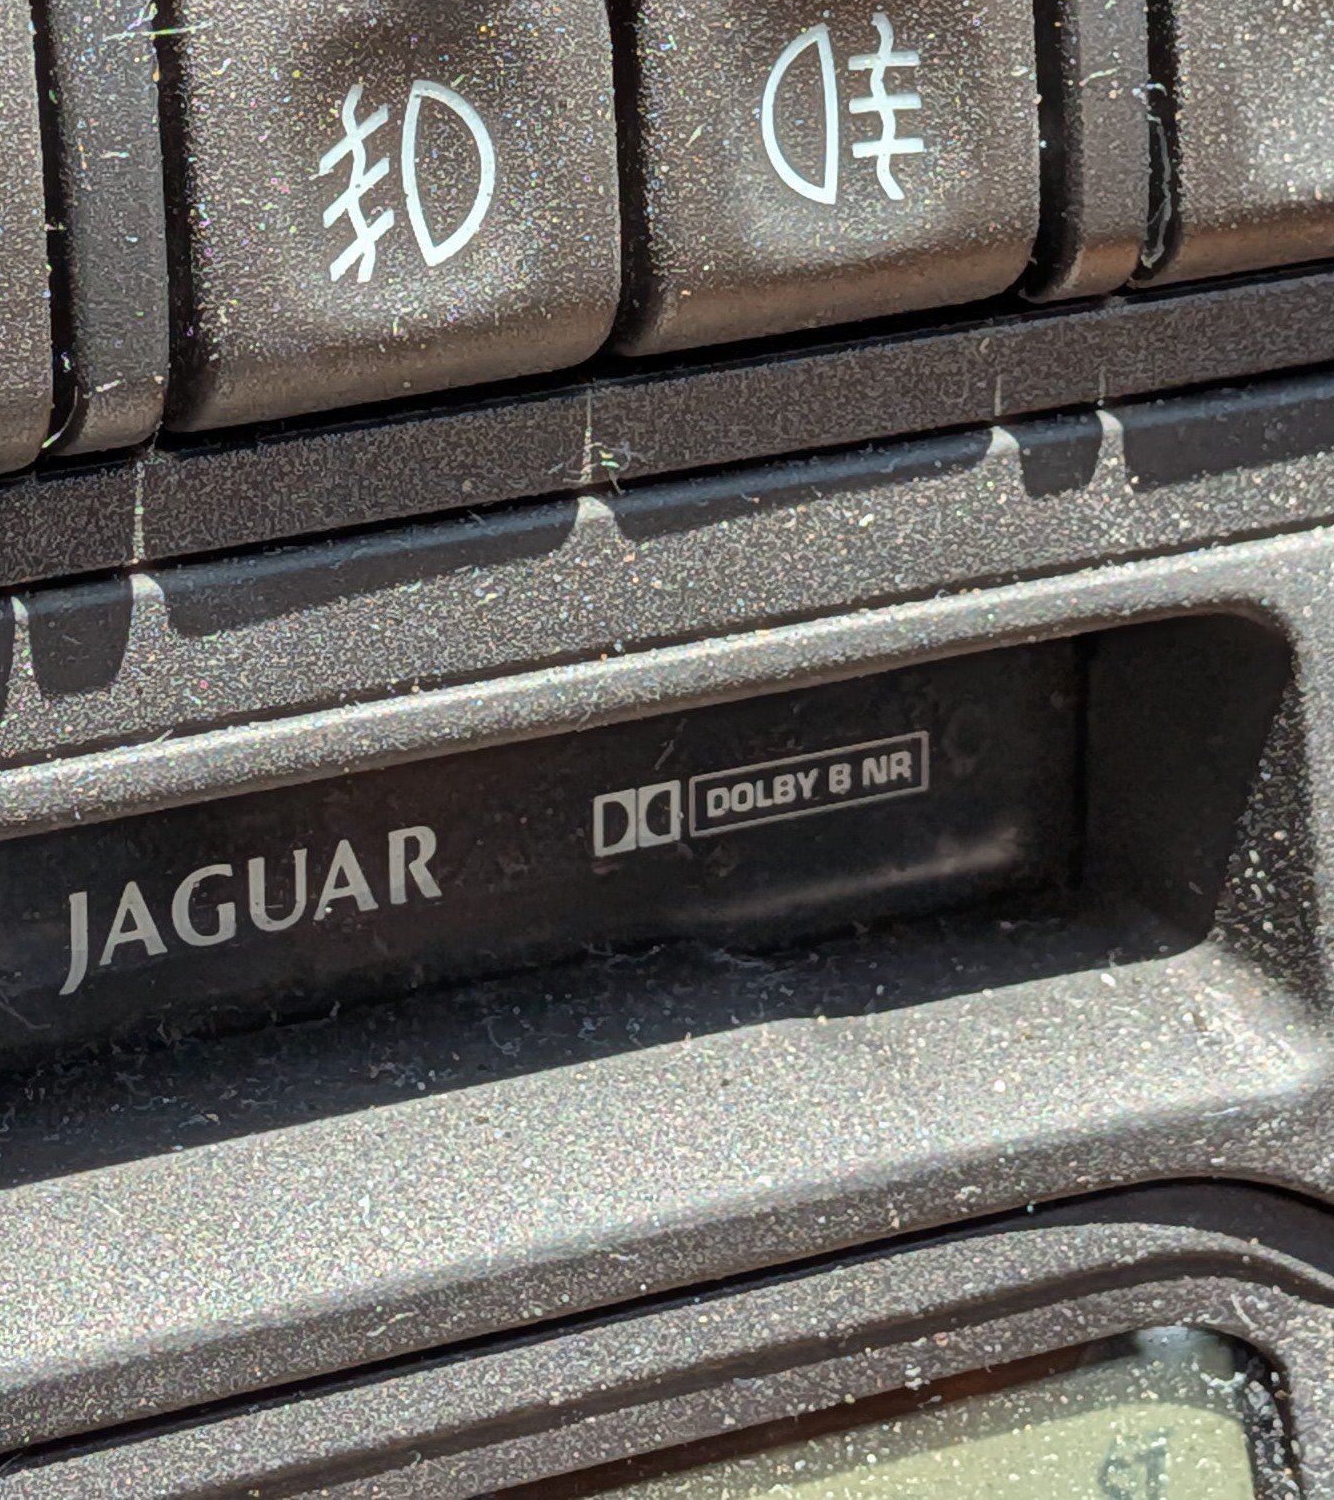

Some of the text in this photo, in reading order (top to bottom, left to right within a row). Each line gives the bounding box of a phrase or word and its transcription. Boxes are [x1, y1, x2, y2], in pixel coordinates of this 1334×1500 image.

[706, 750, 913, 818] DOLBY B NR
[59, 825, 442, 995] JAGUAR
